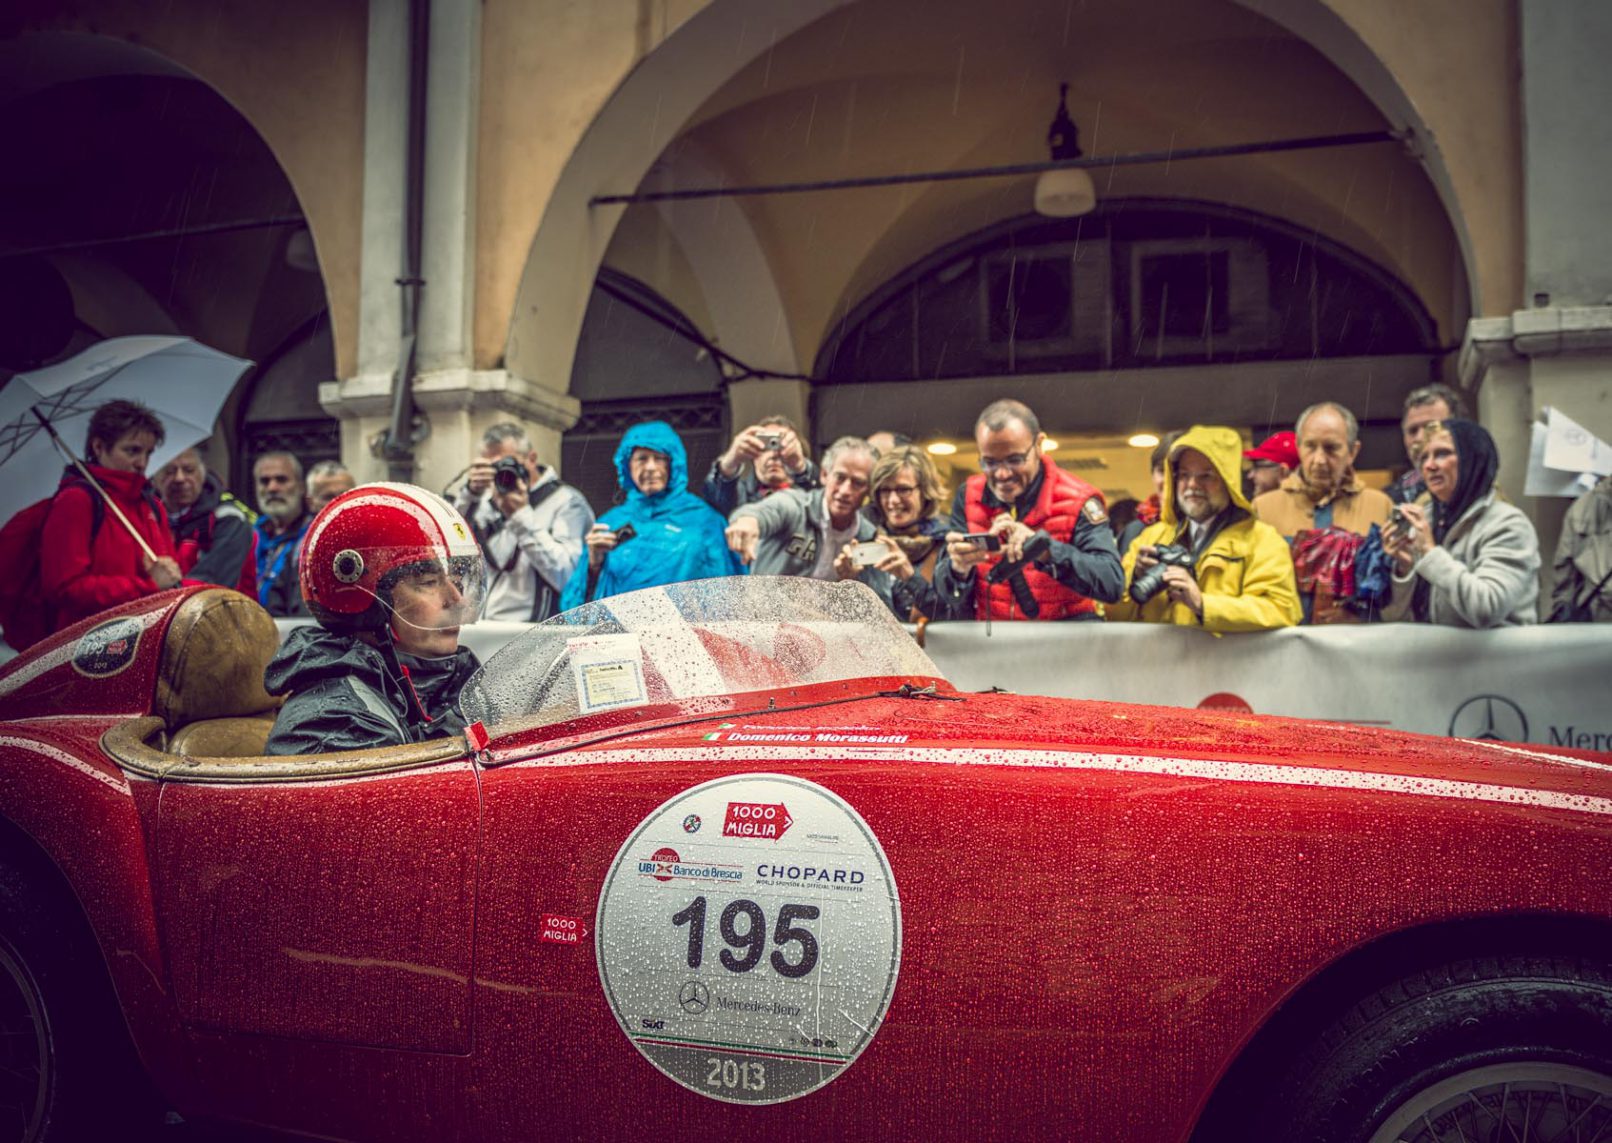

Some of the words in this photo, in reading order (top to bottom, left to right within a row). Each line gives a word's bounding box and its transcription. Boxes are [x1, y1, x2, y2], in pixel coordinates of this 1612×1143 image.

[727, 732, 811, 742] Domenico
[814, 732, 908, 744] Morassutti
[732, 806, 776, 819] 1000
[726, 822, 776, 836] MIGLIA
[638, 862, 656, 873] UBI
[673, 863, 701, 876] Banco
[702, 865, 709, 876] di
[711, 867, 743, 879] Brescia
[757, 864, 865, 884] CHOPARD
[547, 918, 576, 930] 1000
[543, 930, 577, 942] MIGLIA
[672, 896, 820, 978] 195
[717, 997, 800, 1017] Mercedes-Benz
[706, 1057, 766, 1091] 2013
